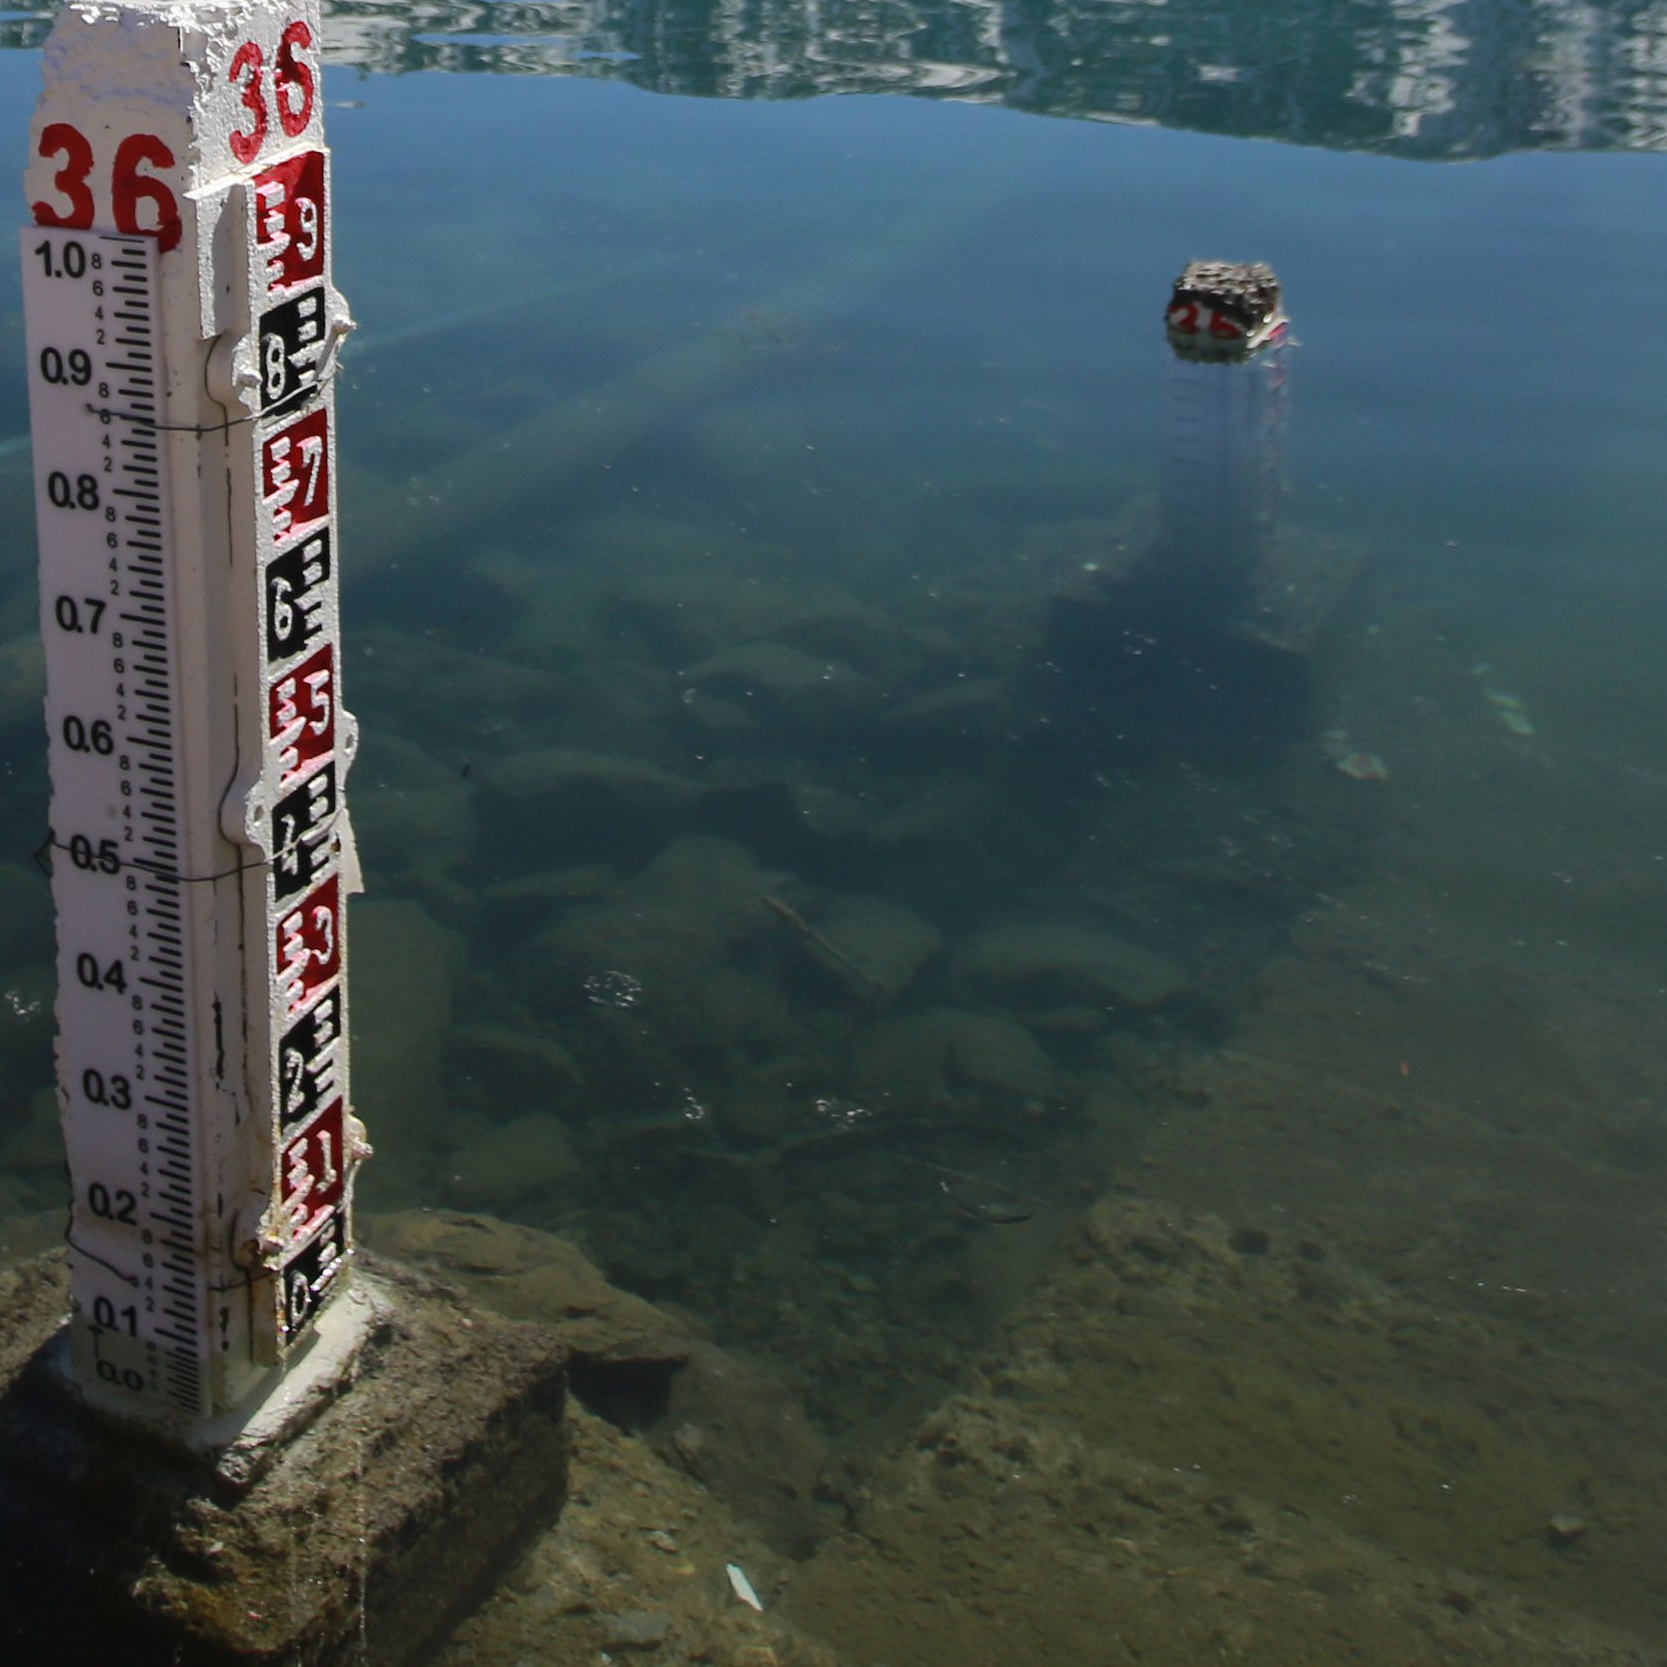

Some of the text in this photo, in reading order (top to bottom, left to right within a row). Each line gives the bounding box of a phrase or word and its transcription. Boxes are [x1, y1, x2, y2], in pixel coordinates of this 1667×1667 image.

[230, 21, 314, 164] 36
[32, 123, 182, 252] 36
[295, 197, 318, 261] 9
[35, 240, 86, 278] 1.0
[91, 253, 102, 269] 8
[93, 281, 104, 296] 6
[95, 306, 104, 321] 4
[97, 329, 105, 345] 2
[40, 347, 92, 385] 0.9
[265, 333, 285, 400] 8
[98, 383, 109, 398] 8
[100, 409, 111, 424] 6
[102, 434, 111, 448] 4
[103, 457, 112, 472] 2
[296, 436, 323, 507] 7
[48, 471, 100, 511] 0.8
[105, 506, 116, 522] 8
[107, 533, 118, 548] 6
[109, 558, 118, 573] 4
[110, 580, 119, 595] 2
[55, 595, 106, 634] 0.7
[271, 577, 293, 641] 6
[112, 632, 123, 648] 8
[114, 658, 124, 673] 6
[116, 683, 124, 696] 4
[303, 669, 330, 735] 5
[117, 705, 126, 720] 2
[63, 715, 114, 755] 0.6
[119, 755, 130, 770] 8
[120, 780, 131, 796] 6
[123, 805, 131, 819] 4
[124, 826, 133, 841] 2
[70, 834, 120, 874] 0.5
[312, 905, 333, 965] 3
[77, 953, 127, 994] 0.4
[285, 1047, 305, 1113] 2
[83, 1069, 132, 1110] 0.3
[89, 1182, 137, 1226] 0.2
[94, 1296, 136, 1337] 0.1
